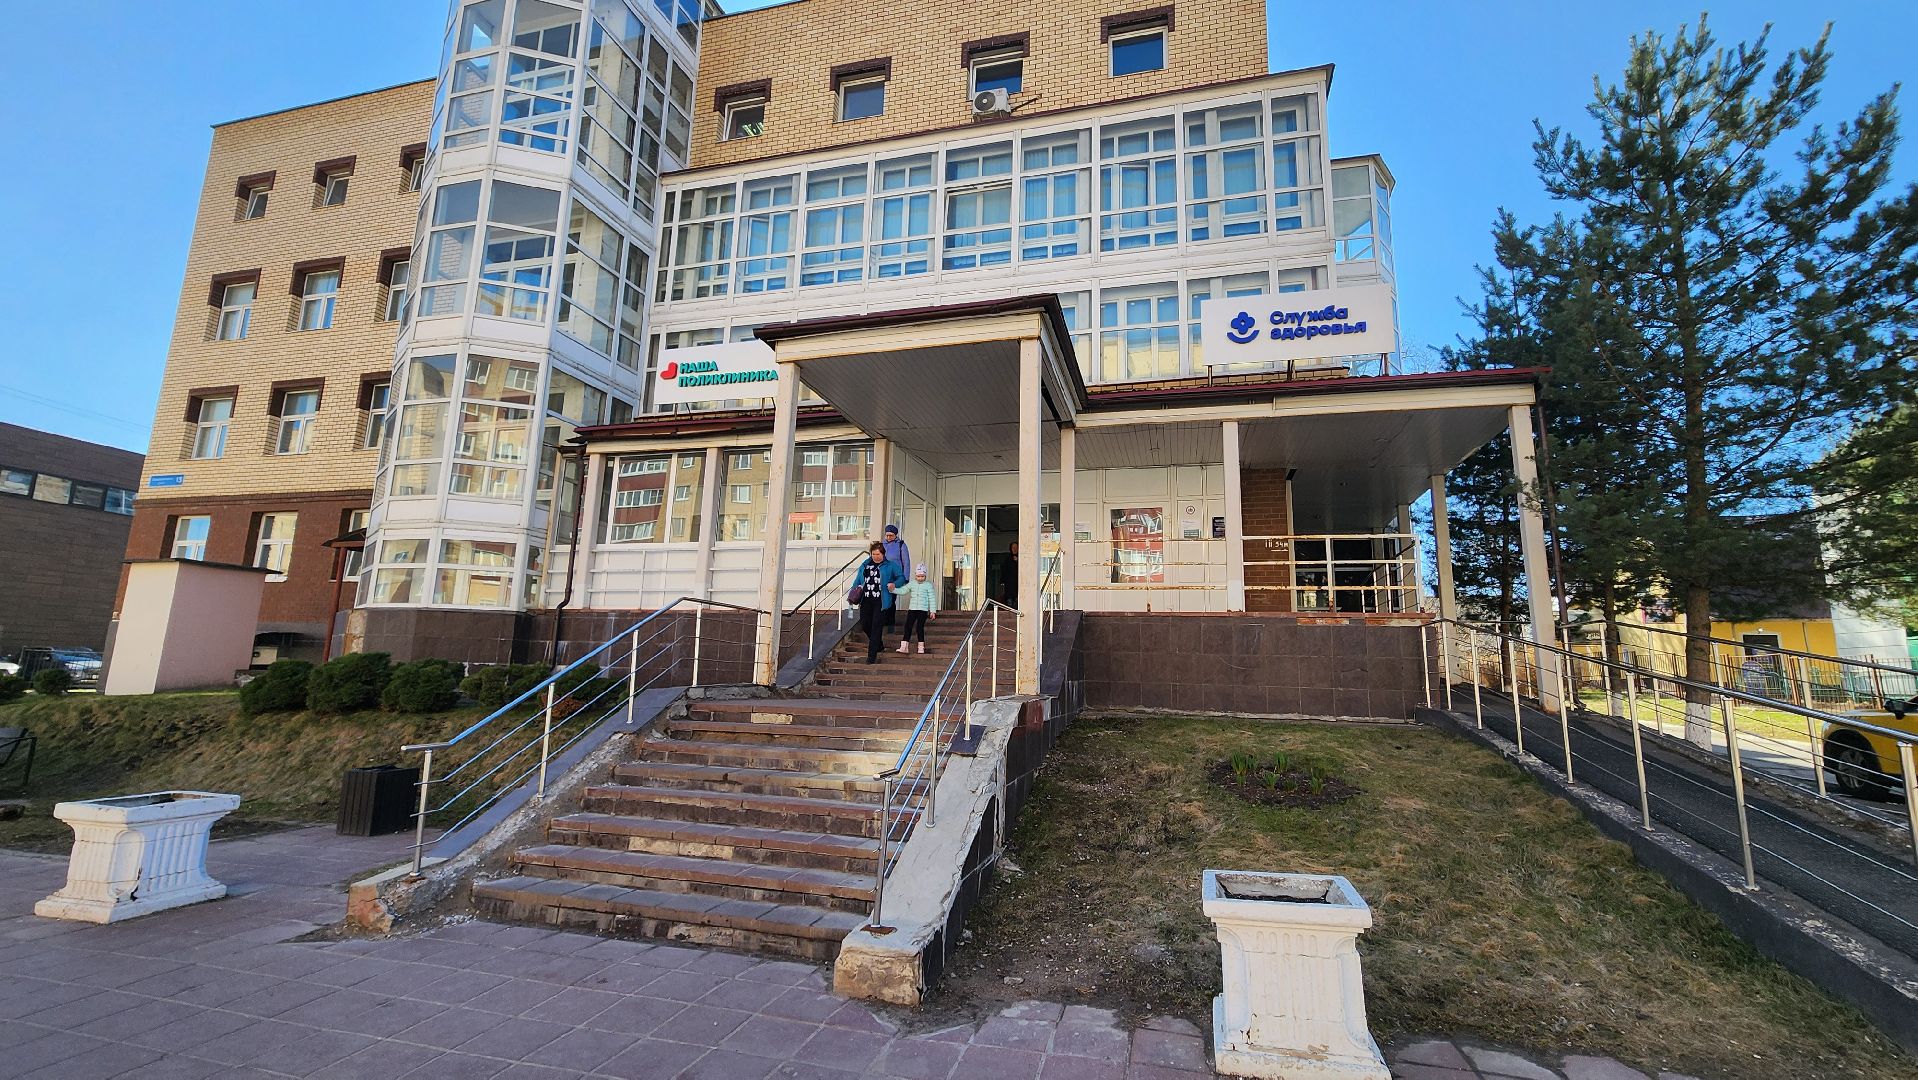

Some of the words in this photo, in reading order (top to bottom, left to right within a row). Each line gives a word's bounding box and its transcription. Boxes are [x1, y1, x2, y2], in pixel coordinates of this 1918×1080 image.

[1269, 305, 1348, 326] Служба
[1270, 321, 1367, 340] здоровья
[679, 360, 718, 374] НАША
[678, 369, 778, 387] ПОЛИКЛИНИКА
